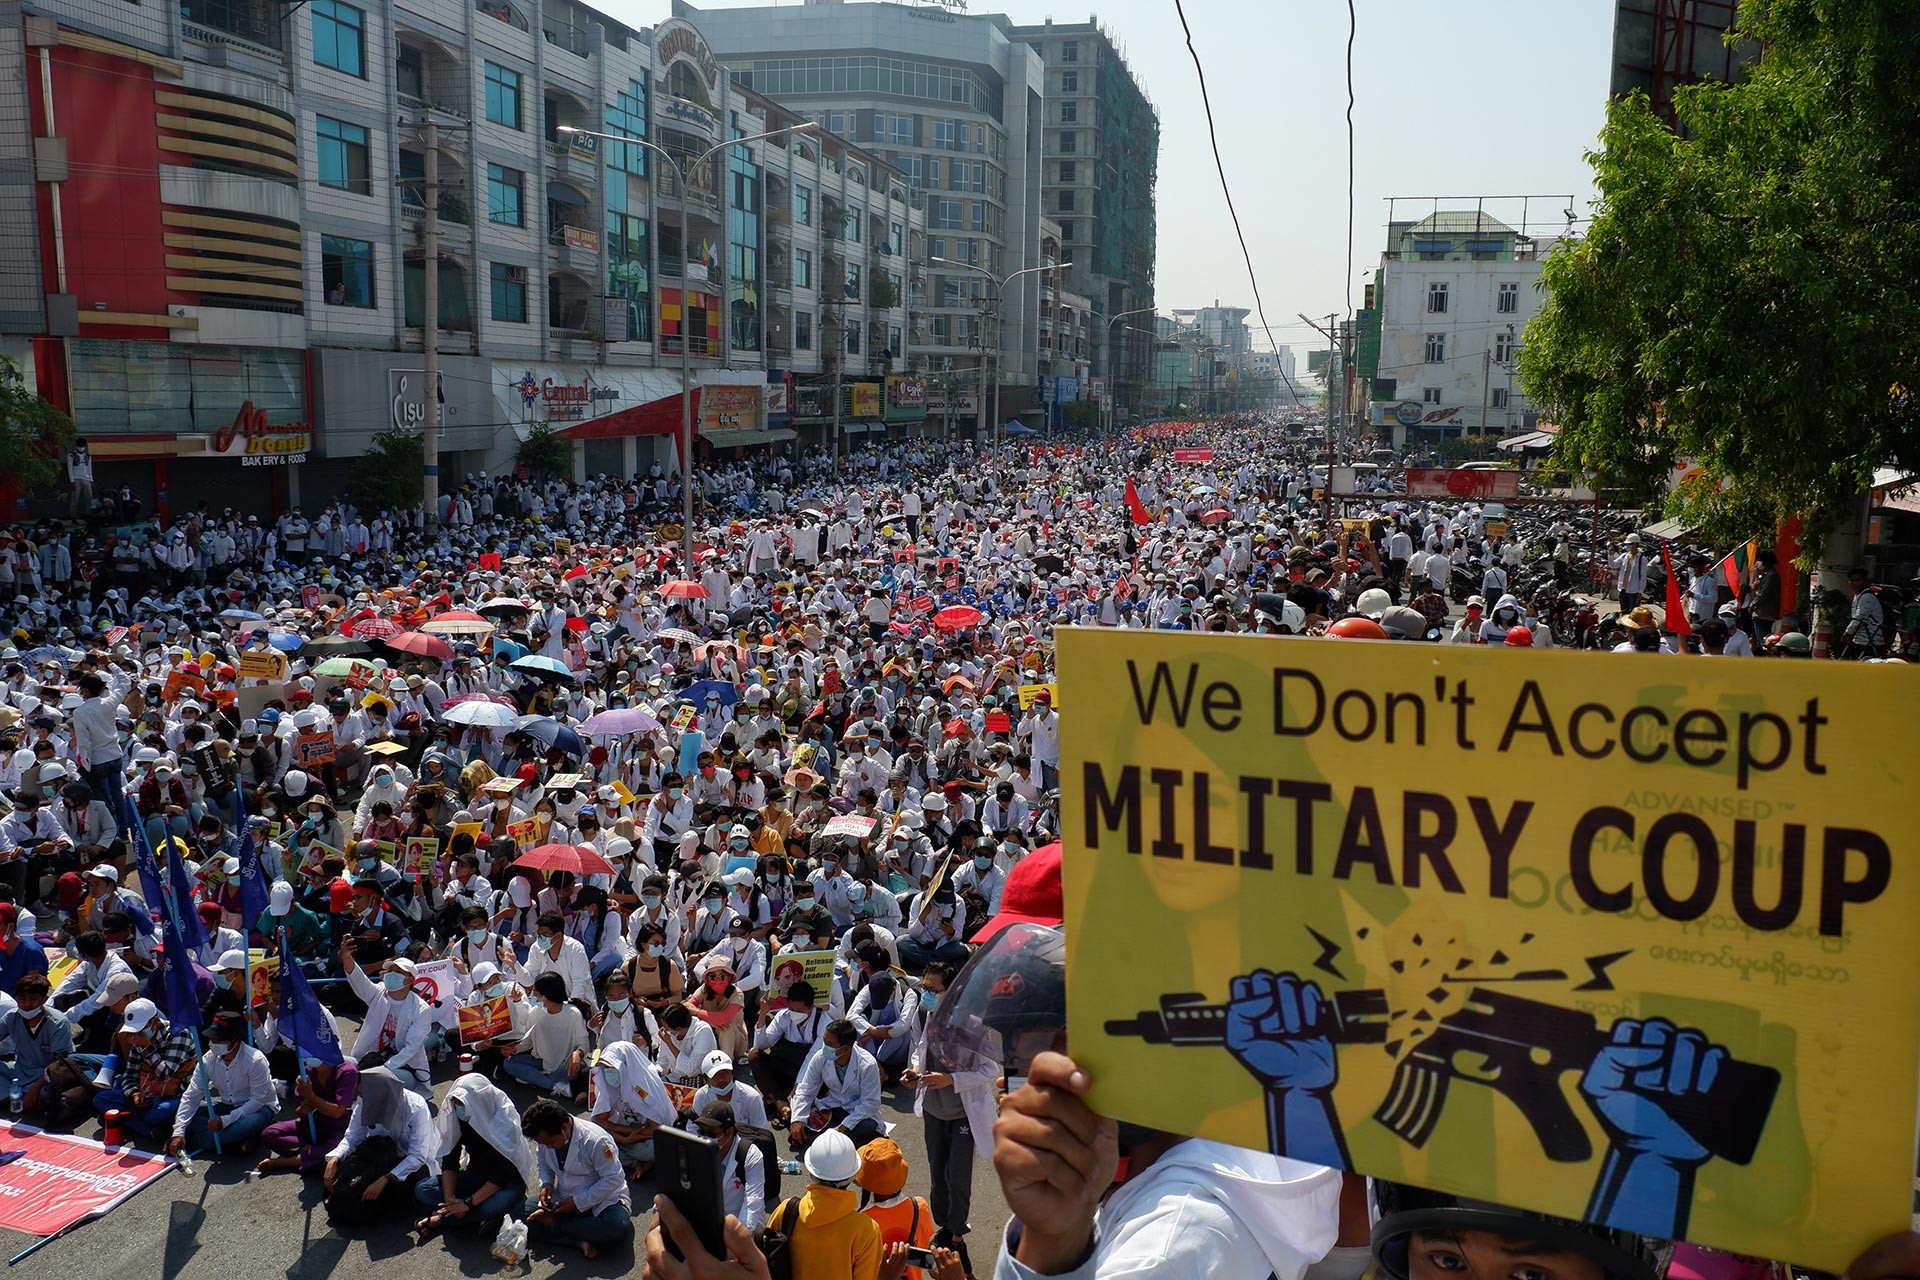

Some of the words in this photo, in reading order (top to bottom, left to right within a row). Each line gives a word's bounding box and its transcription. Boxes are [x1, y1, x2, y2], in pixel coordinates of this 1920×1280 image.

[542, 377, 589, 402] Central
[288, 454, 306, 464] FOODS
[1127, 659, 1242, 735] We
[1273, 667, 1475, 750] Don't
[1498, 680, 1828, 790] Accept
[1083, 761, 1535, 900] MILITARY
[1569, 805, 1891, 937] COUP
[805, 957, 833, 966] Release
[428, 964, 447, 973] COUP
[804, 972, 831, 980] Leaders
